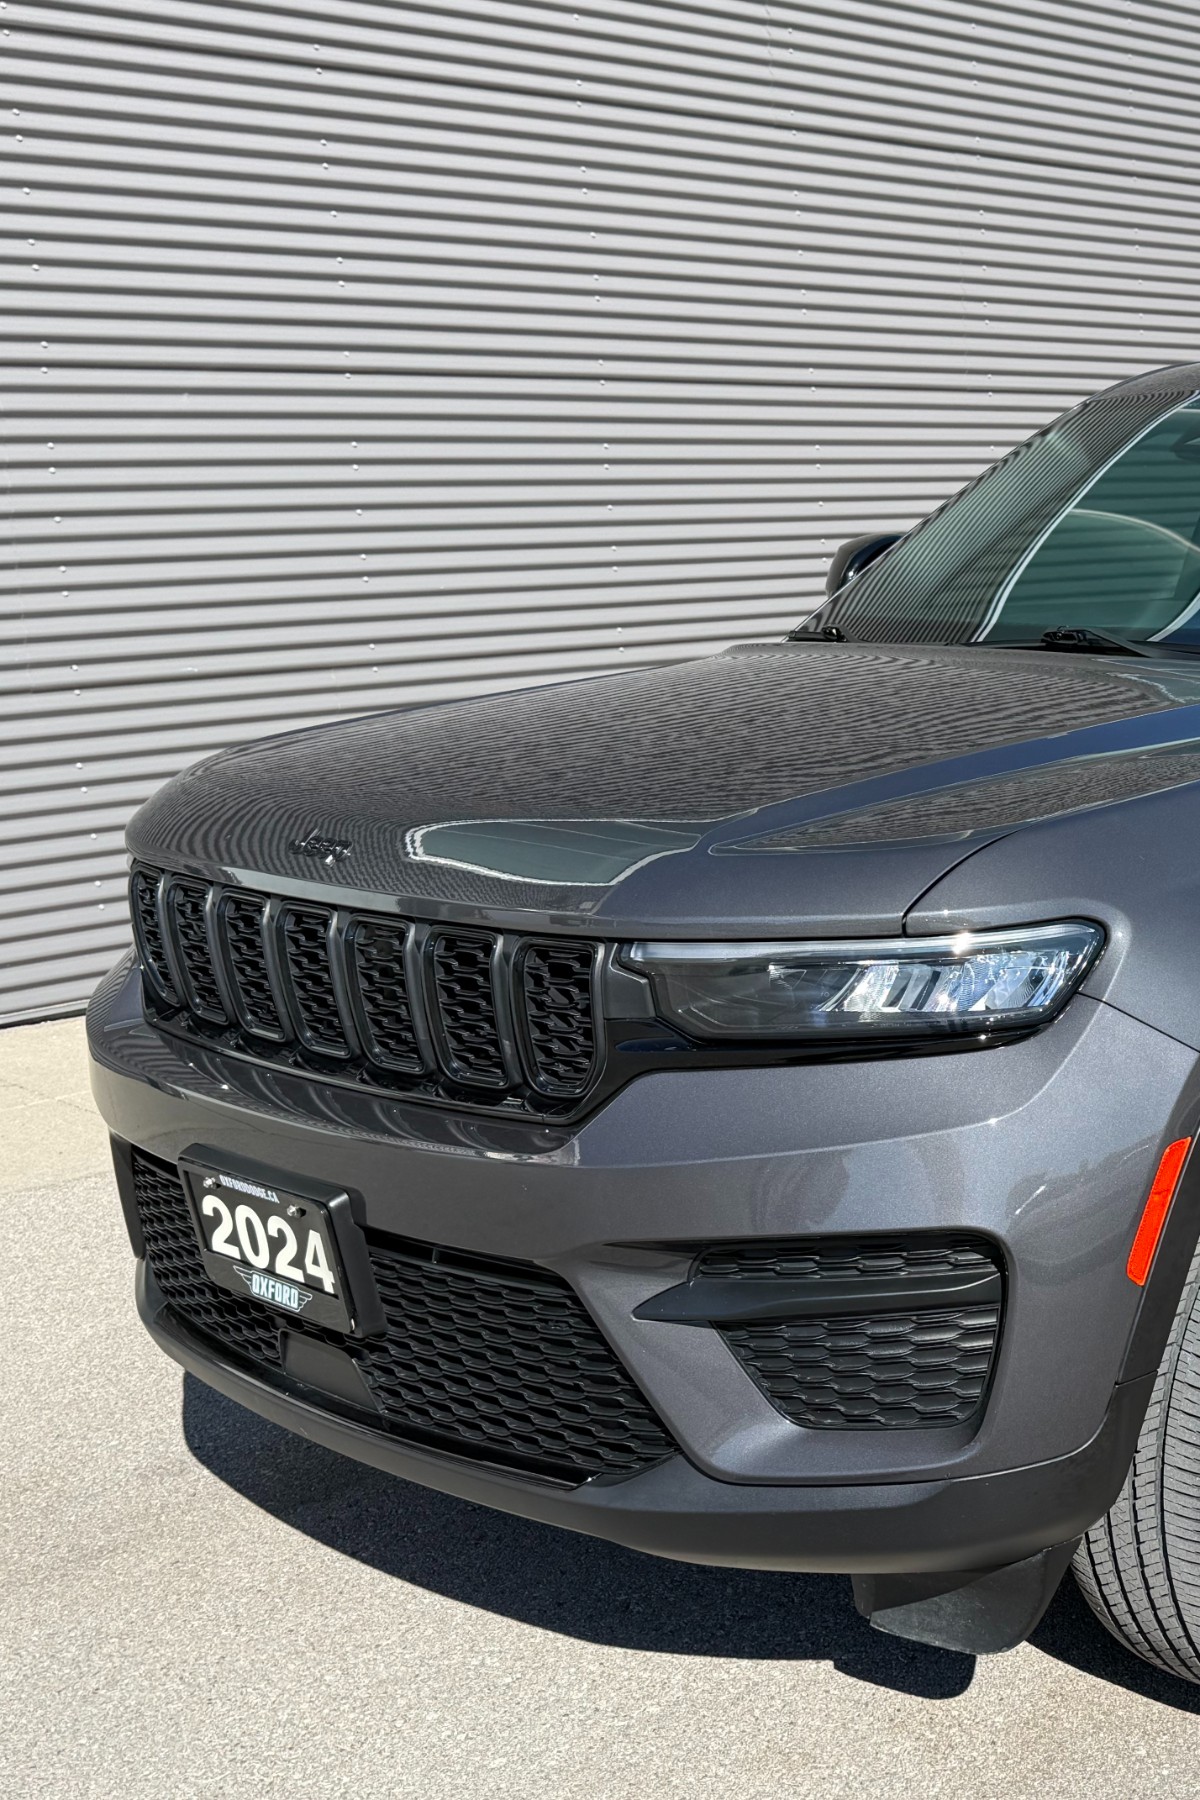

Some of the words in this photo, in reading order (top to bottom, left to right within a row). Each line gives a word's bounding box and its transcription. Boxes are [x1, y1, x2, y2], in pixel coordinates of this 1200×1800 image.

[288, 827, 353, 867] Jeep
[202, 1194, 336, 1294] 2024
[252, 1273, 300, 1309] OXFORD
